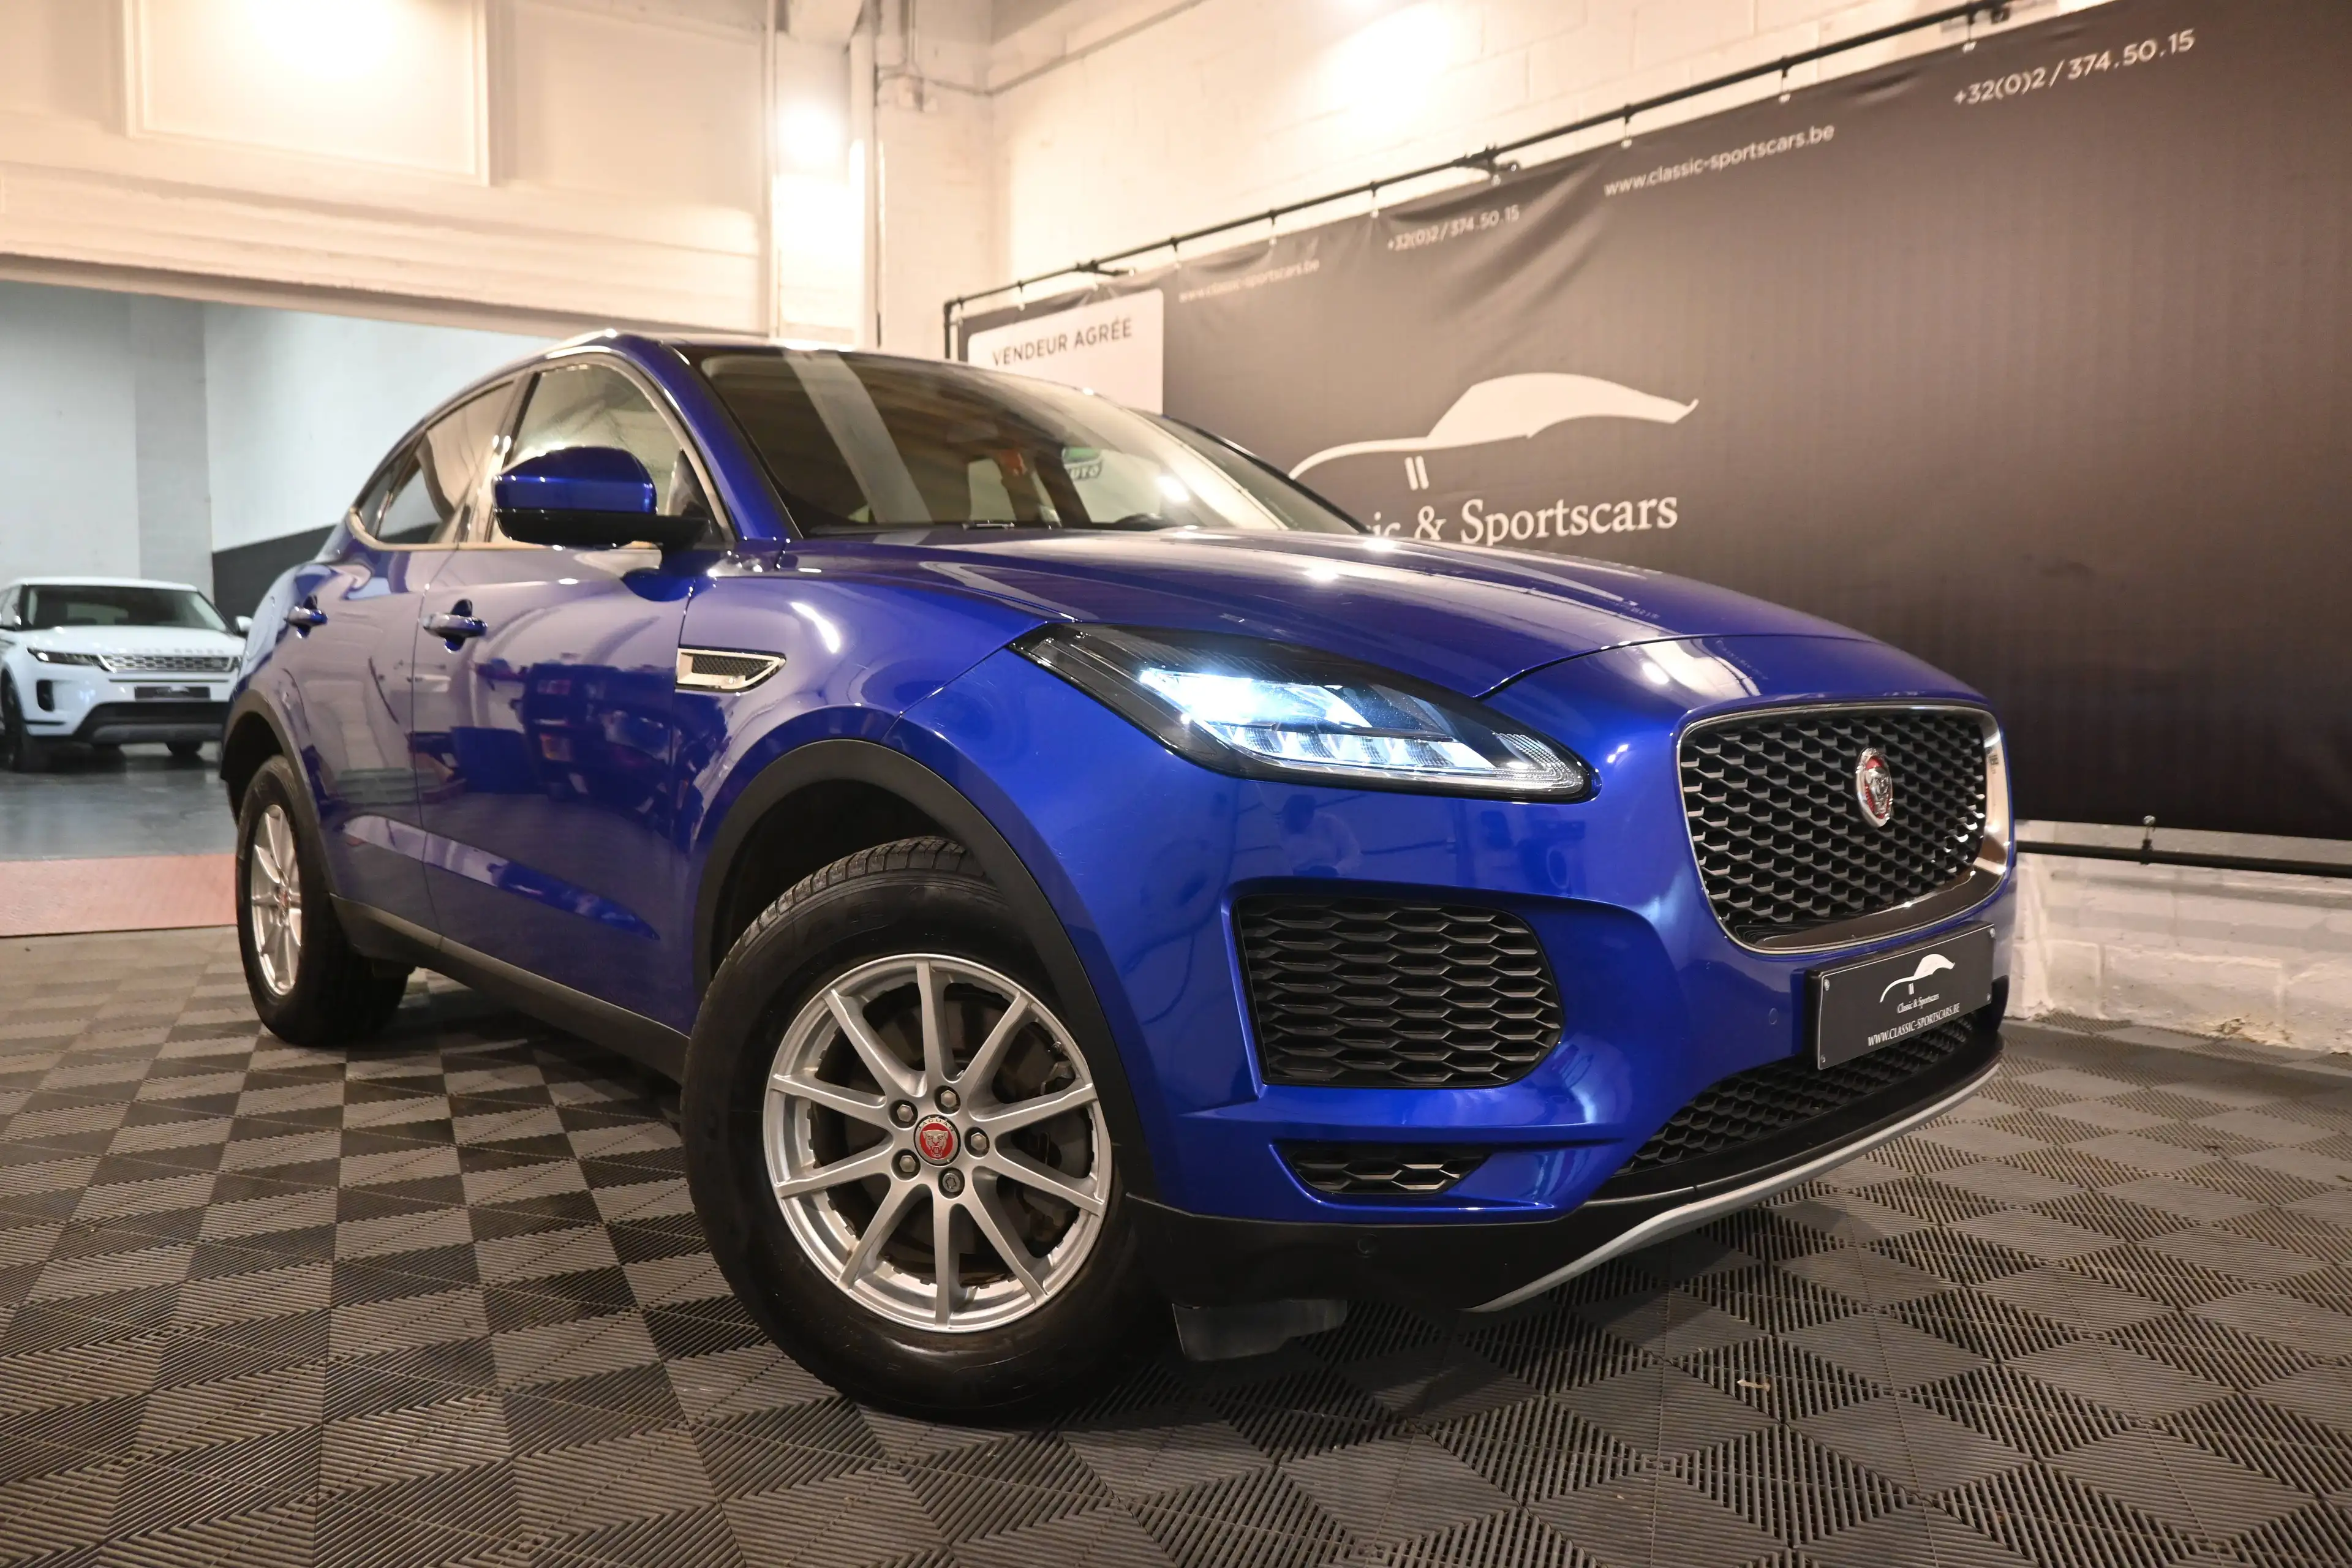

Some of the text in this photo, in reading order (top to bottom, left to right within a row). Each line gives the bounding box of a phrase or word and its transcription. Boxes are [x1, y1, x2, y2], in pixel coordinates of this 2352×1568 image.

[1604, 124, 1835, 197] www.classic-sportscars.be
[992, 315, 1133, 366] VENDEUR AGRÉE
[1414, 505, 1447, 541] &
[1460, 496, 1678, 547] Sportscars
[1867, 1002, 1961, 1047] WWW.CLASSIC-SPORTSCARS.BE
[918, 1118, 955, 1132] JAGUAR
